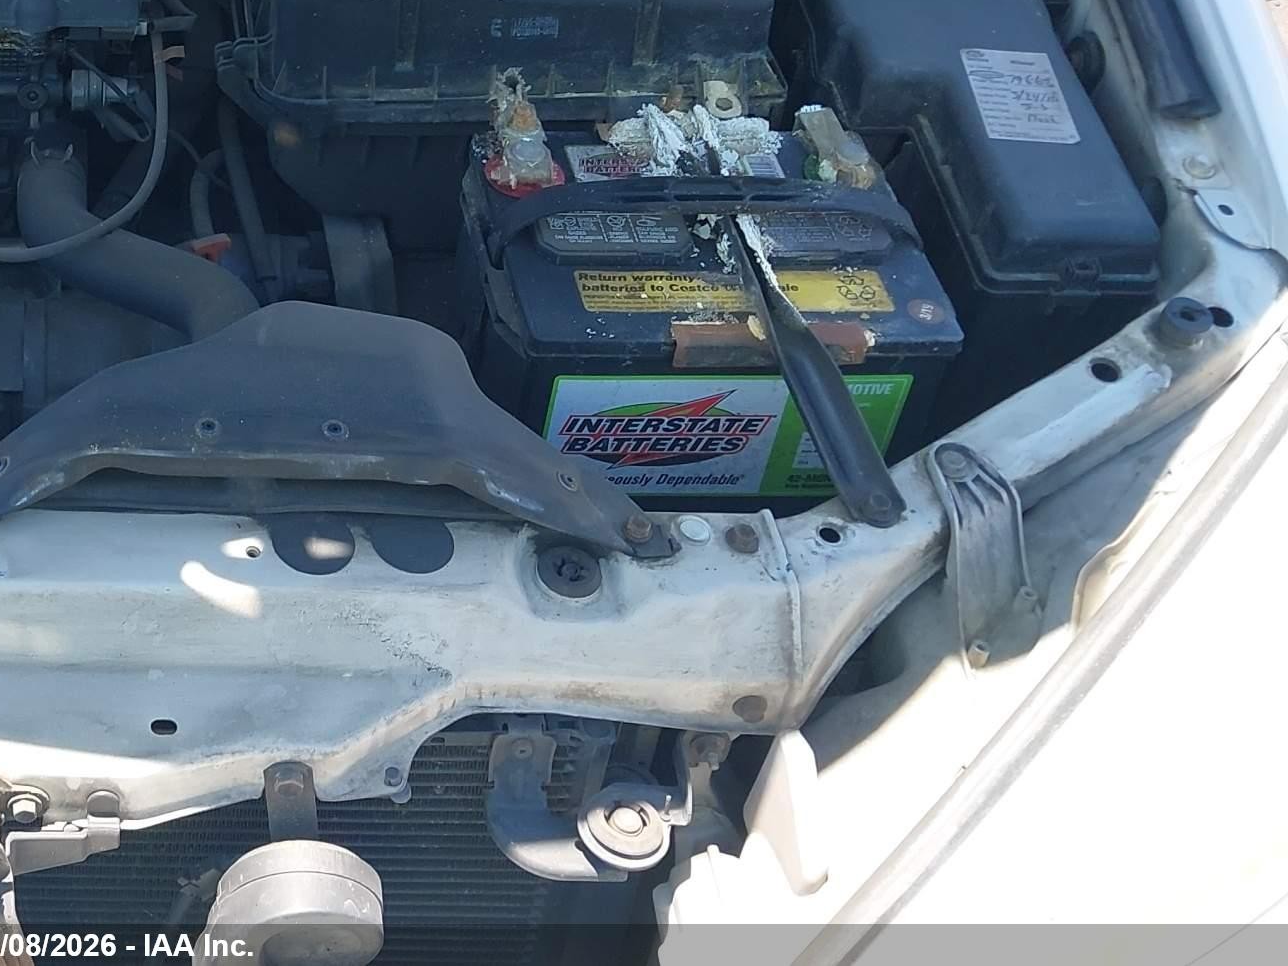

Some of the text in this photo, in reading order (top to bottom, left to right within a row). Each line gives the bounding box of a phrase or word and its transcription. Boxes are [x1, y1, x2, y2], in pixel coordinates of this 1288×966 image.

[578, 272, 696, 283] Return warranty
[582, 283, 646, 293] batteries
[650, 283, 664, 292] to
[668, 283, 720, 293] Costco
[563, 415, 765, 434] INTERSTATE
[563, 436, 746, 453] BATTERIES
